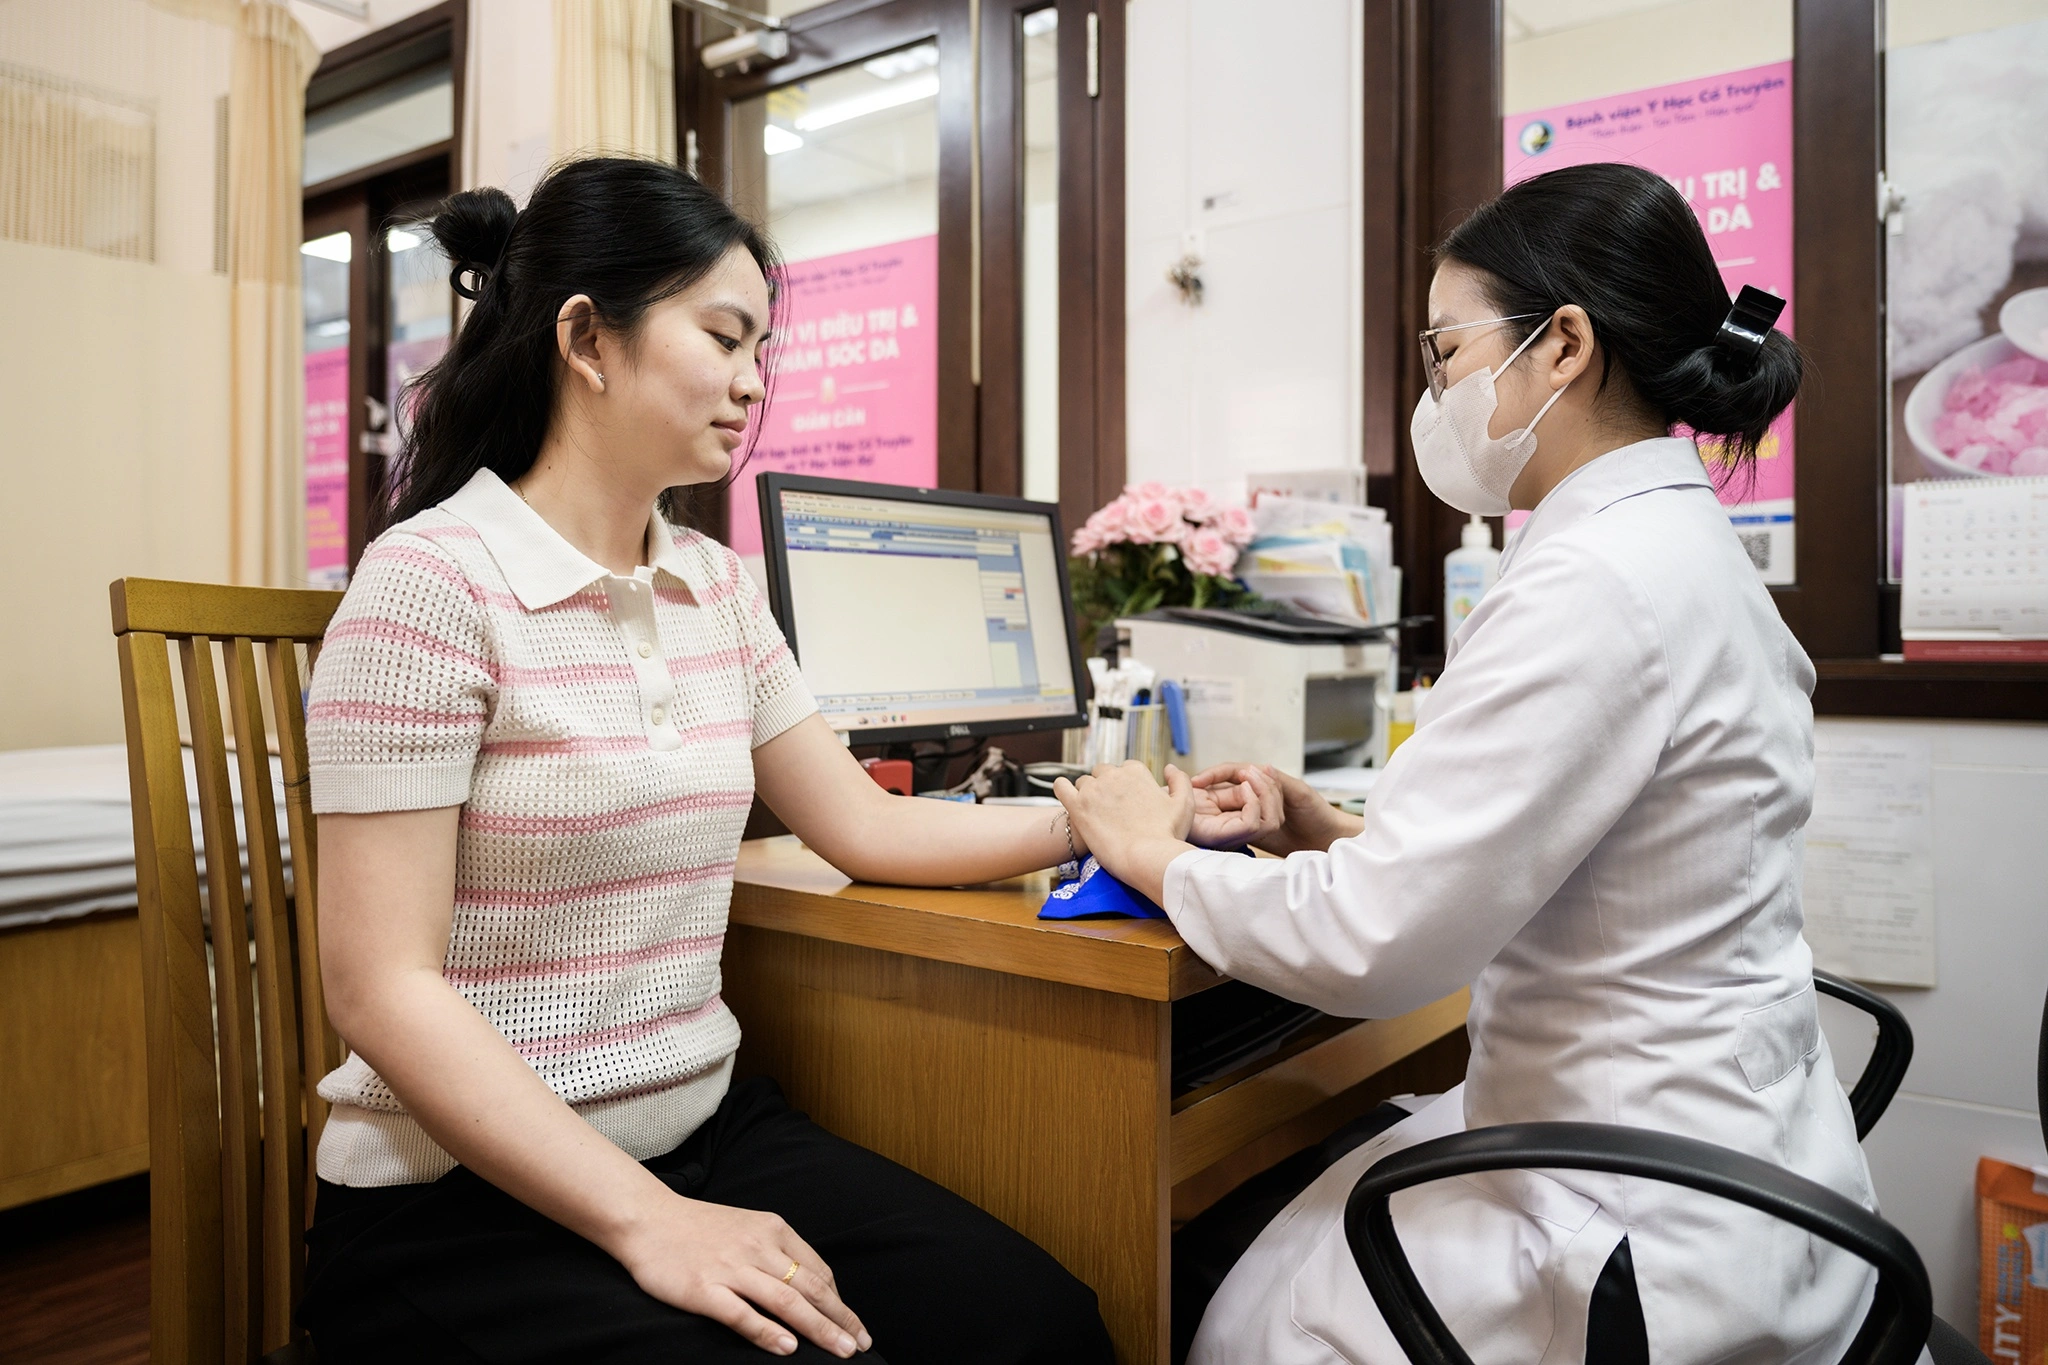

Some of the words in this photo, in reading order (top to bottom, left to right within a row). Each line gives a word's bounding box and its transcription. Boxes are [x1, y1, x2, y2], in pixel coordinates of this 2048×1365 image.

[1566, 112, 1604, 129] Bệnh
[1648, 100, 1657, 111] Y
[1727, 78, 1785, 99] Truyền
[1702, 167, 1747, 200] TRỊ
[1756, 162, 1781, 191] &
[1708, 202, 1752, 234] DA
[1993, 1303, 2021, 1365] ITY
